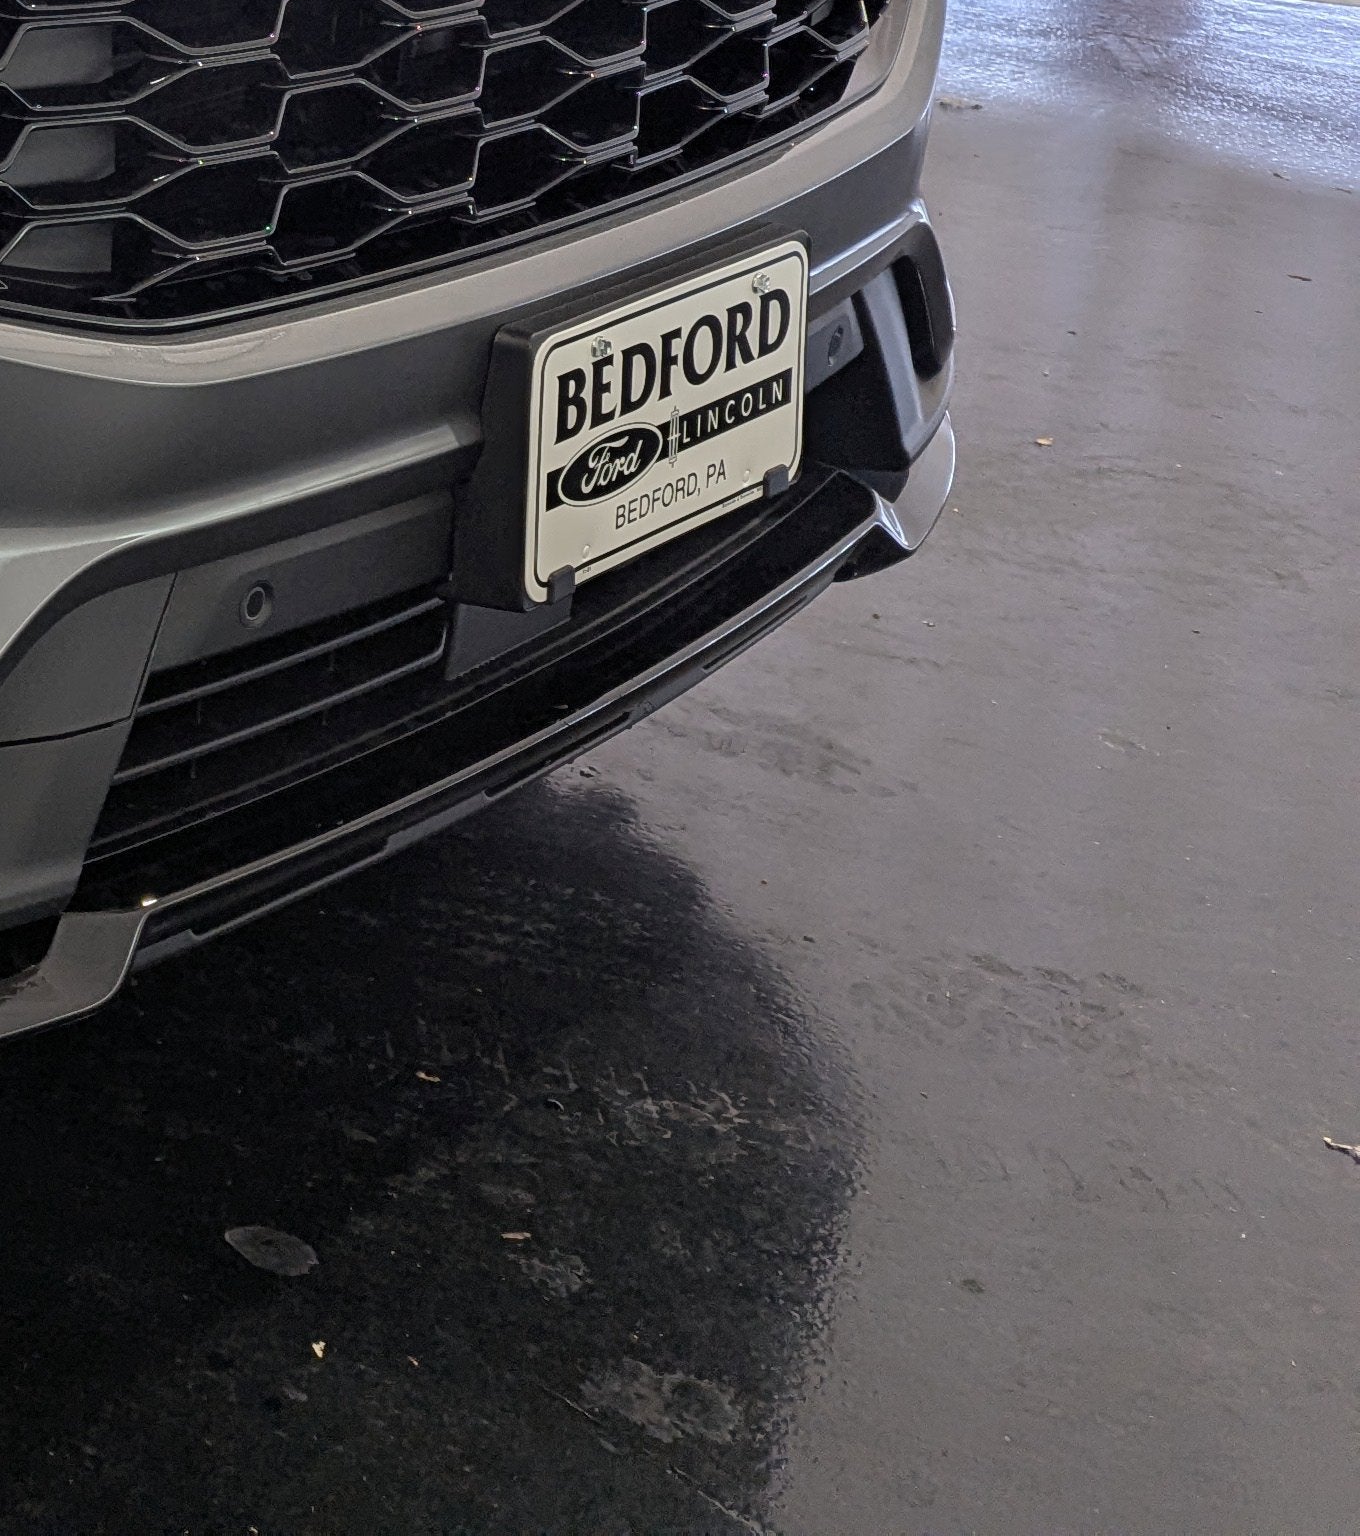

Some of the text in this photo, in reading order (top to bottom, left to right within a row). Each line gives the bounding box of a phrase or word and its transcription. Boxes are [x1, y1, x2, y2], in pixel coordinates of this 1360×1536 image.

[553, 287, 791, 446] BEDFORD
[681, 377, 786, 444] LINCOLN
[581, 433, 643, 495] Ford
[615, 471, 701, 530] BEDFORD,
[705, 459, 727, 490] PA
